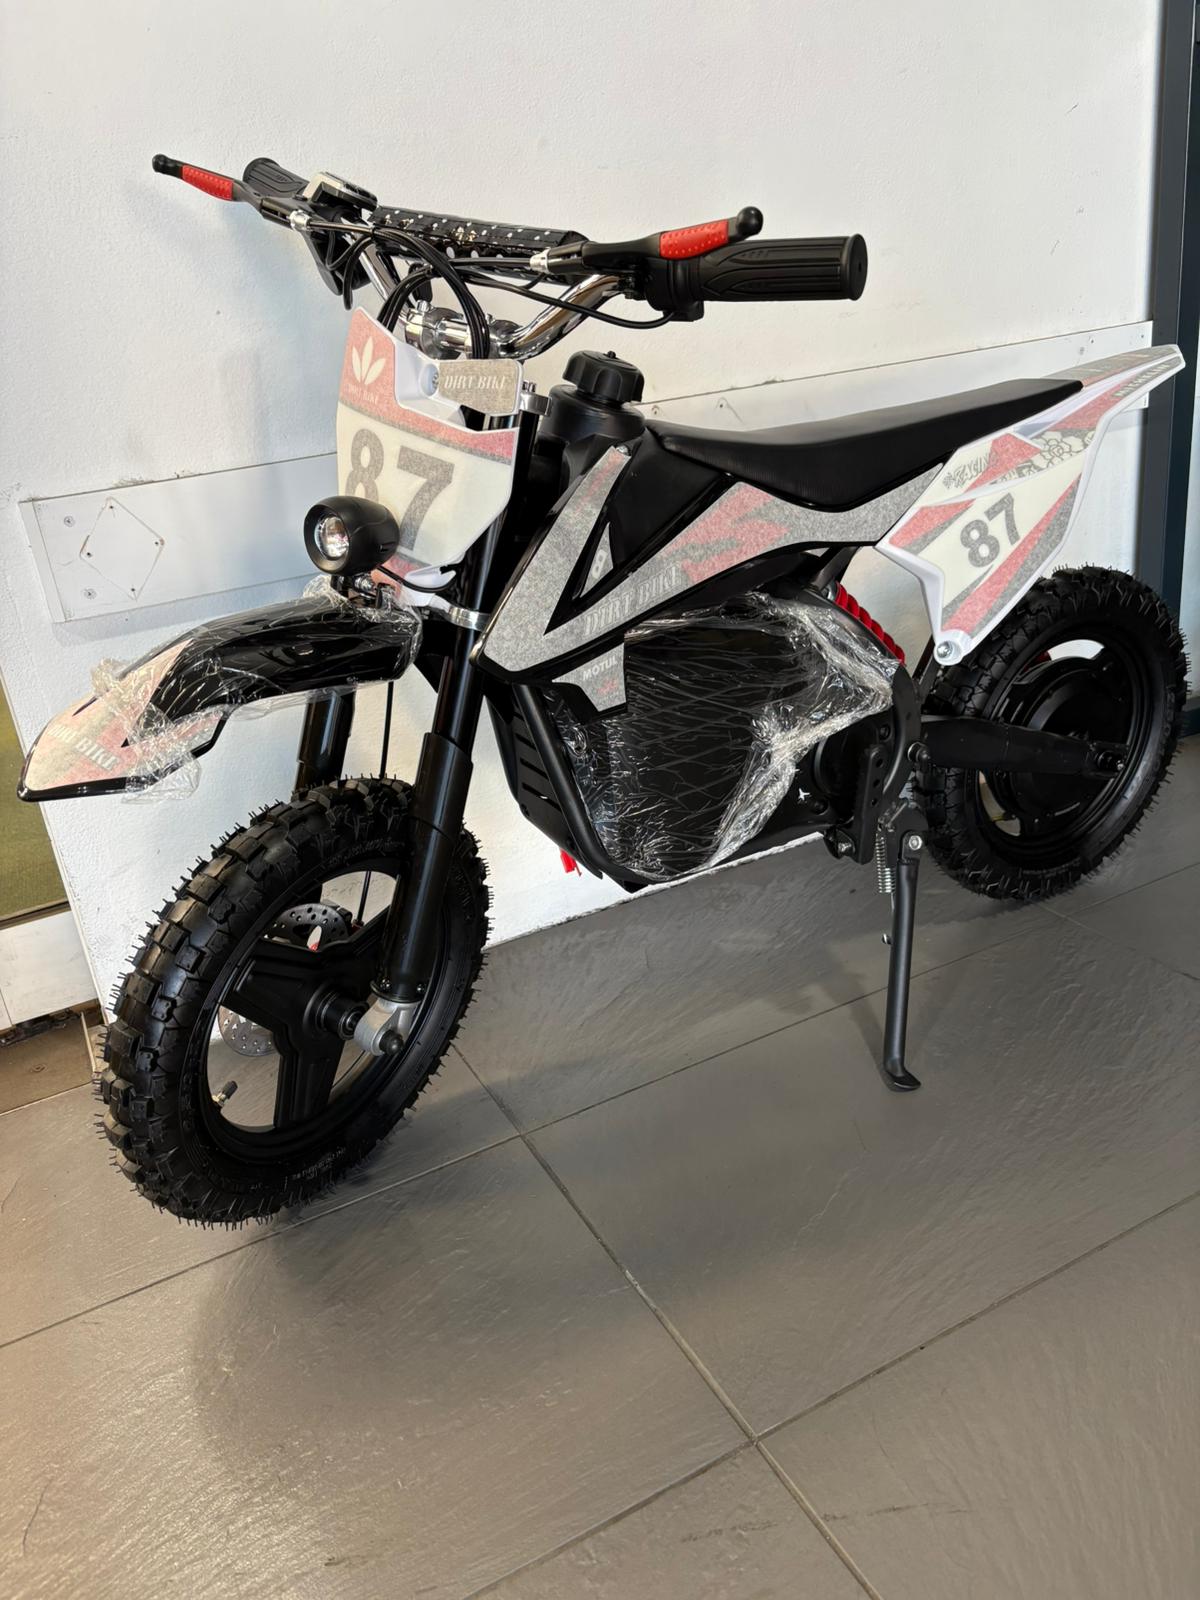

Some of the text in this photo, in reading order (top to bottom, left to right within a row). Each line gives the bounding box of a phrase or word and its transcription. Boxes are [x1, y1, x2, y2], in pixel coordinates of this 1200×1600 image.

[443, 375, 508, 391] DIRT BIKE
[345, 428, 455, 551] 87
[960, 492, 1021, 568] 87
[583, 564, 682, 636] DIRT BIKE
[583, 656, 618, 681] MOTUL
[74, 737, 120, 770] BIKE
